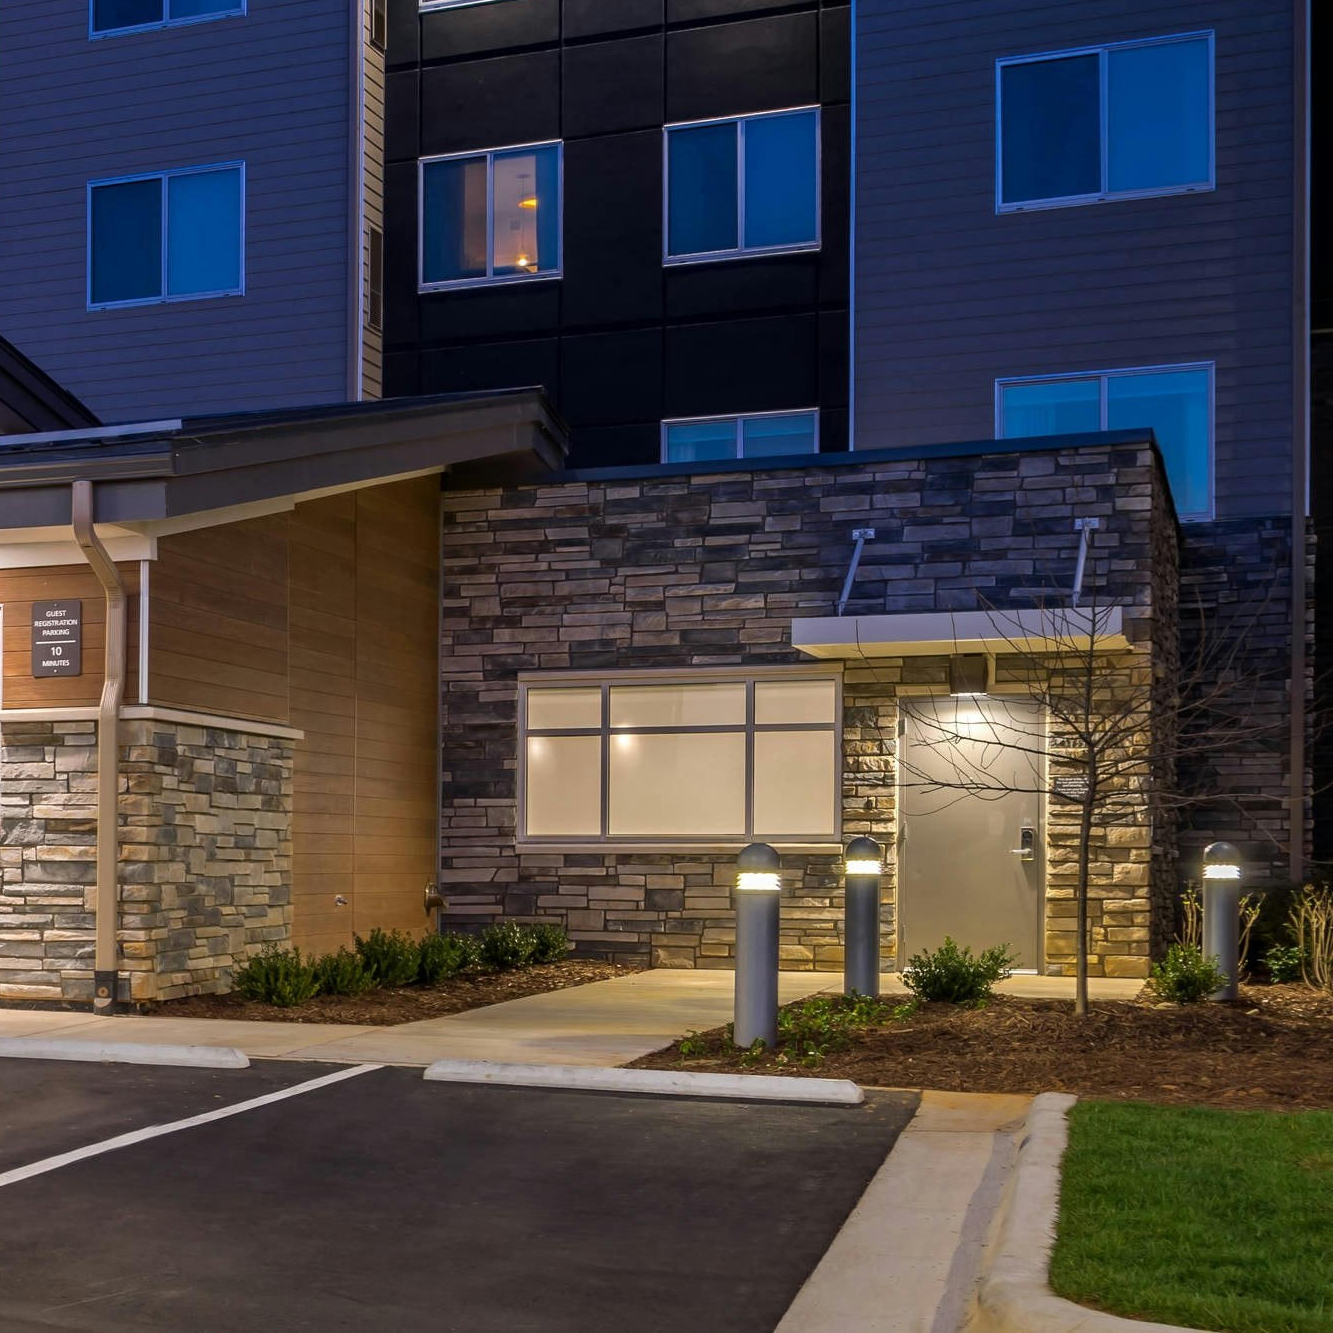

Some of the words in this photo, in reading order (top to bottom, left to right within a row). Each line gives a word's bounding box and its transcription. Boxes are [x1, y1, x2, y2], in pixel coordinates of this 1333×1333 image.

[45, 609, 67, 617] GUEST
[34, 619, 78, 627] REGISTRATION
[42, 628, 70, 636] PARKING
[51, 646, 62, 656] 10
[42, 659, 70, 667] MINUTES
